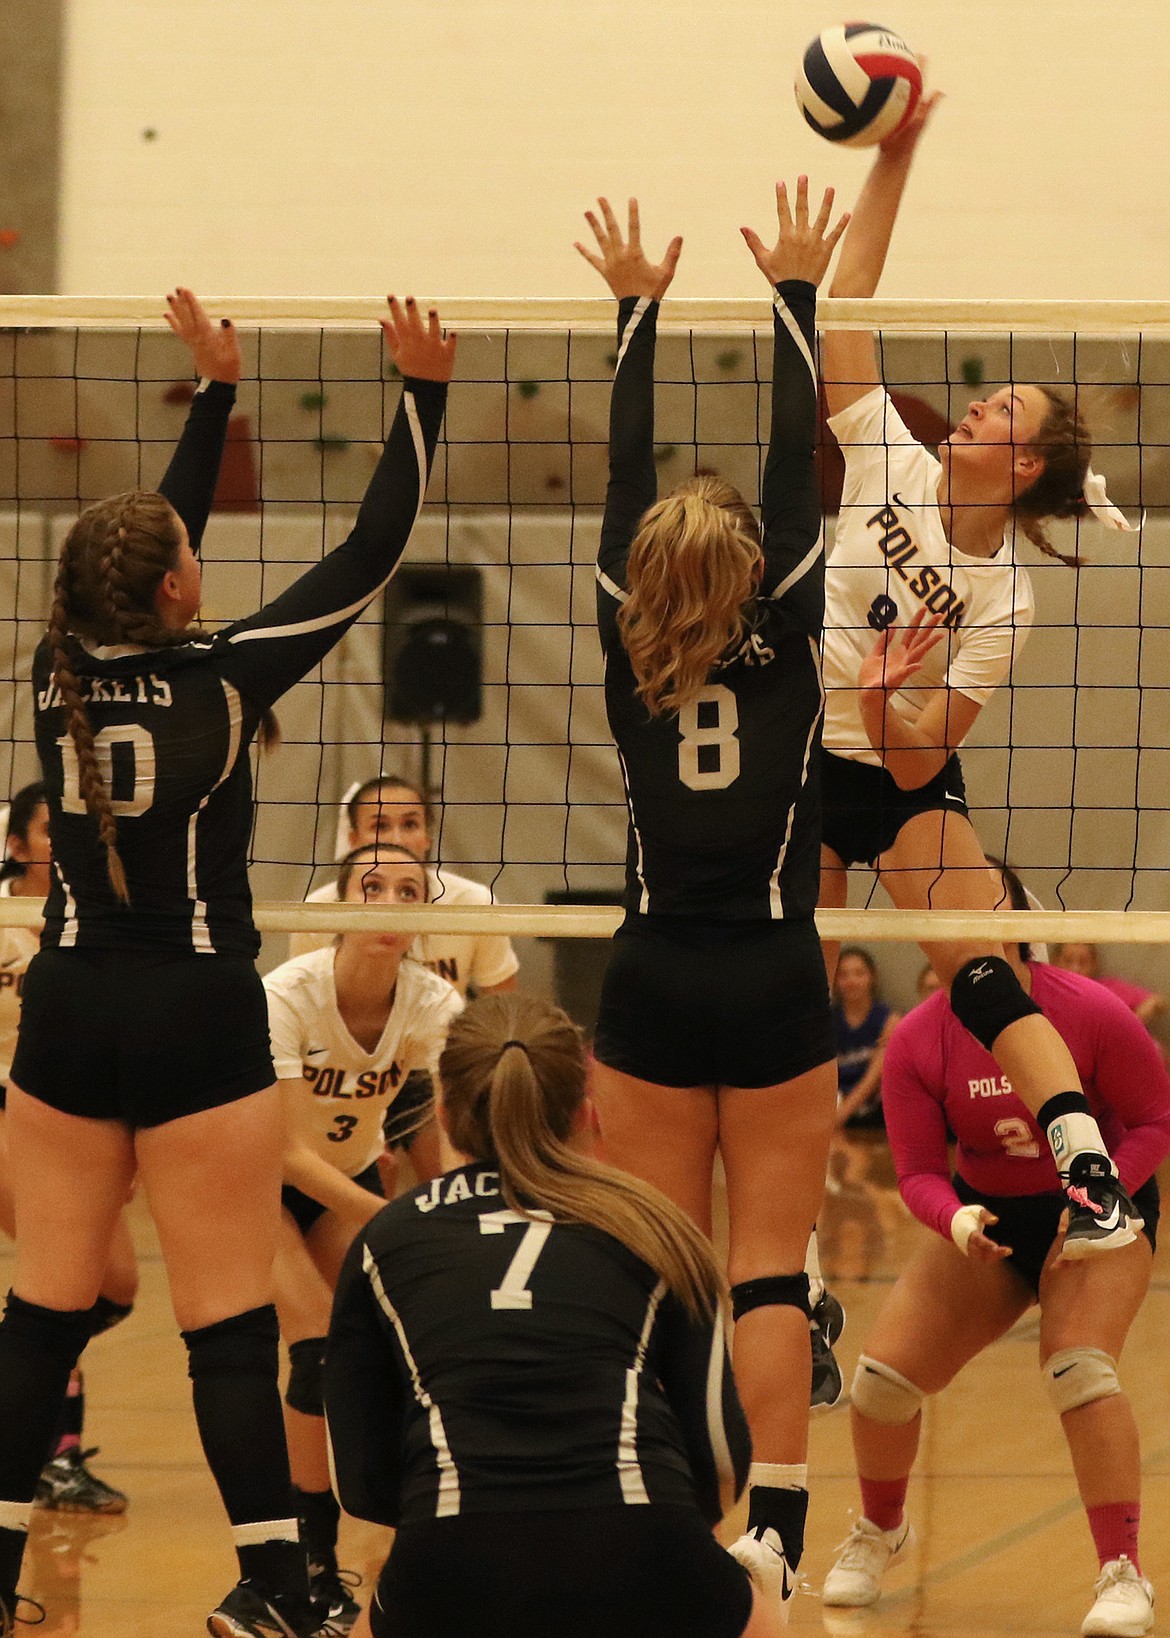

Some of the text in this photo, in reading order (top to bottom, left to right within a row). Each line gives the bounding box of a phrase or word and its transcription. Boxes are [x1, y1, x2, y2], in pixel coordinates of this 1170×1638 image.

[866, 594, 899, 633] 9
[678, 683, 740, 791] 8
[56, 724, 157, 817] 10
[968, 1075, 1013, 1099] POLS
[327, 1113, 359, 1143] 3
[994, 1117, 1040, 1158] 2
[478, 1209, 556, 1311] 7
